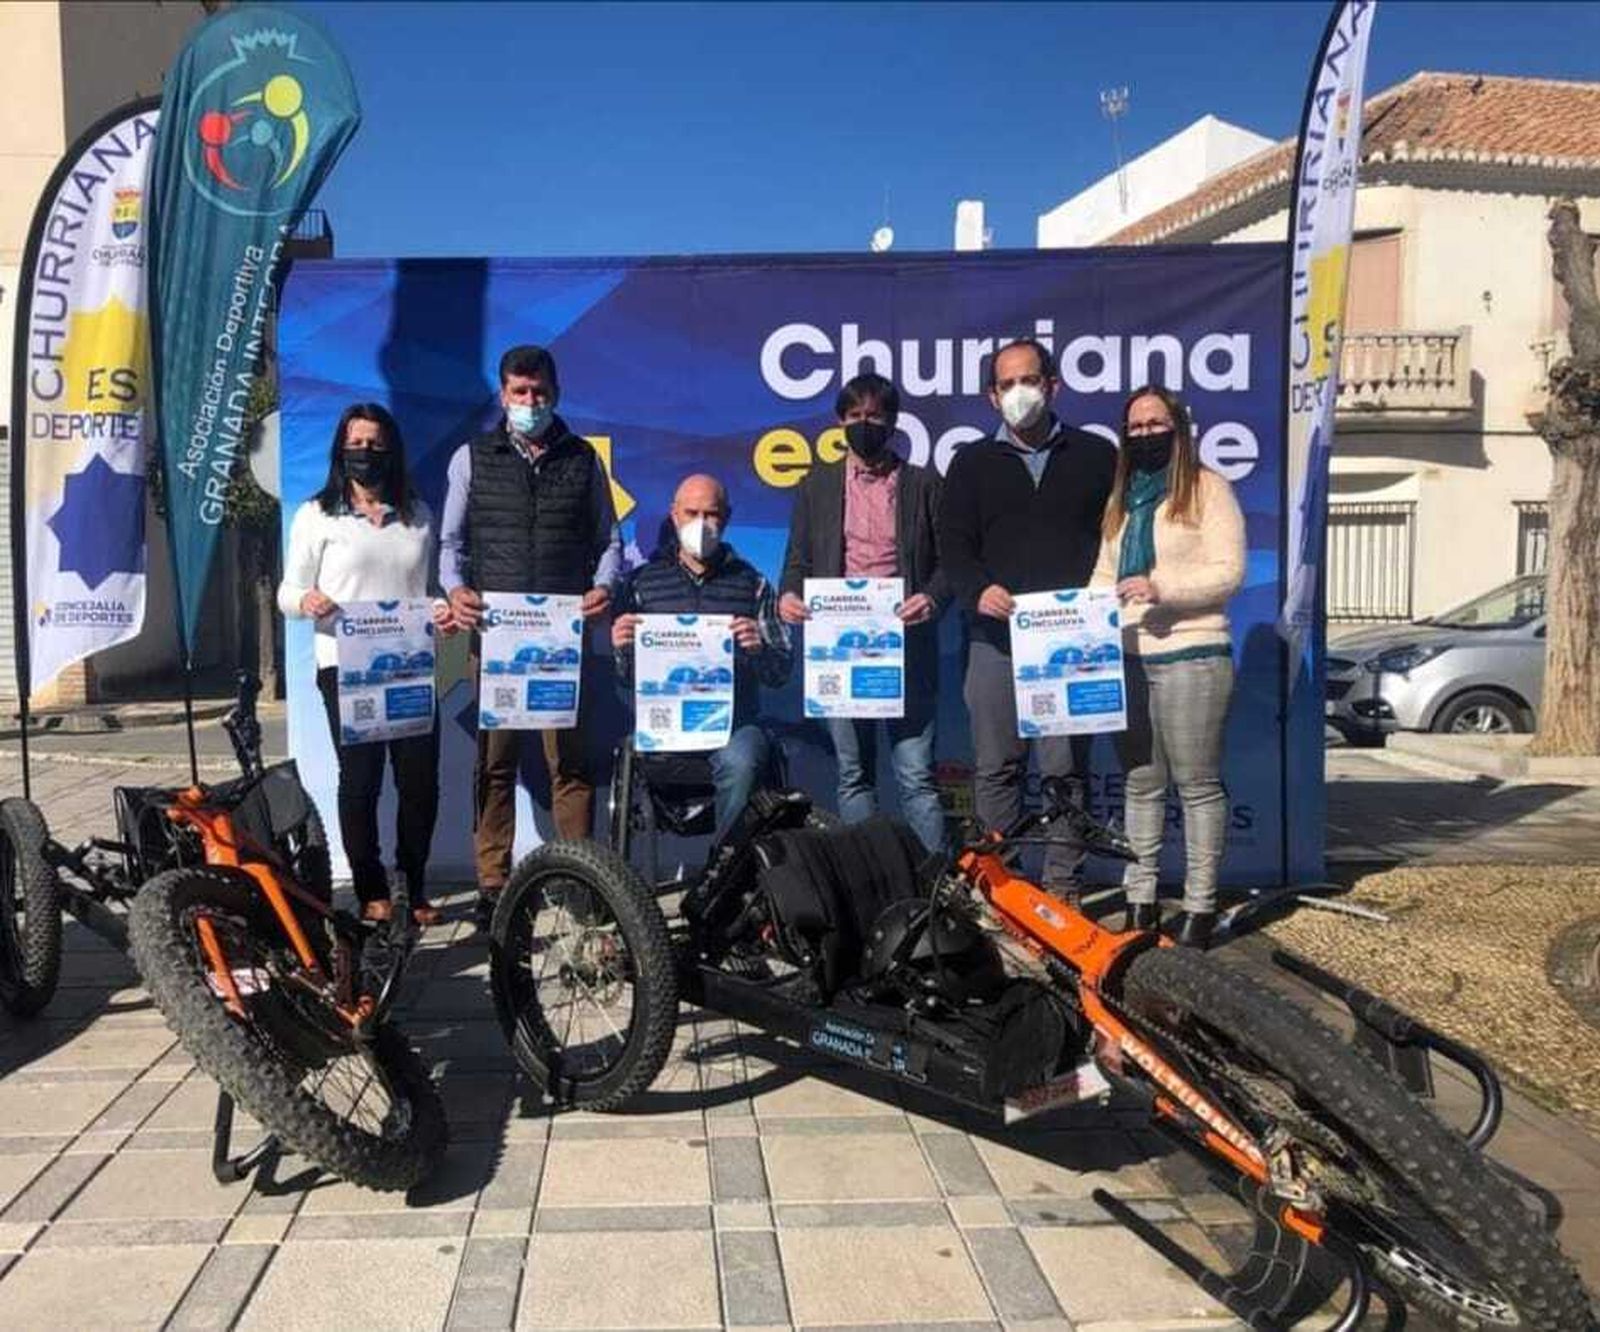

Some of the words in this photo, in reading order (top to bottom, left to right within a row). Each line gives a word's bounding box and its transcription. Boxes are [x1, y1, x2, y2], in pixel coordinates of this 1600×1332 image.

[31, 115, 157, 400] CHURRIANA
[88, 369, 138, 402] ES
[177, 358, 227, 480] Asociación
[216, 244, 264, 352] Deportiva
[760, 319, 1250, 399] Churana
[32, 411, 140, 440] DEPORTE
